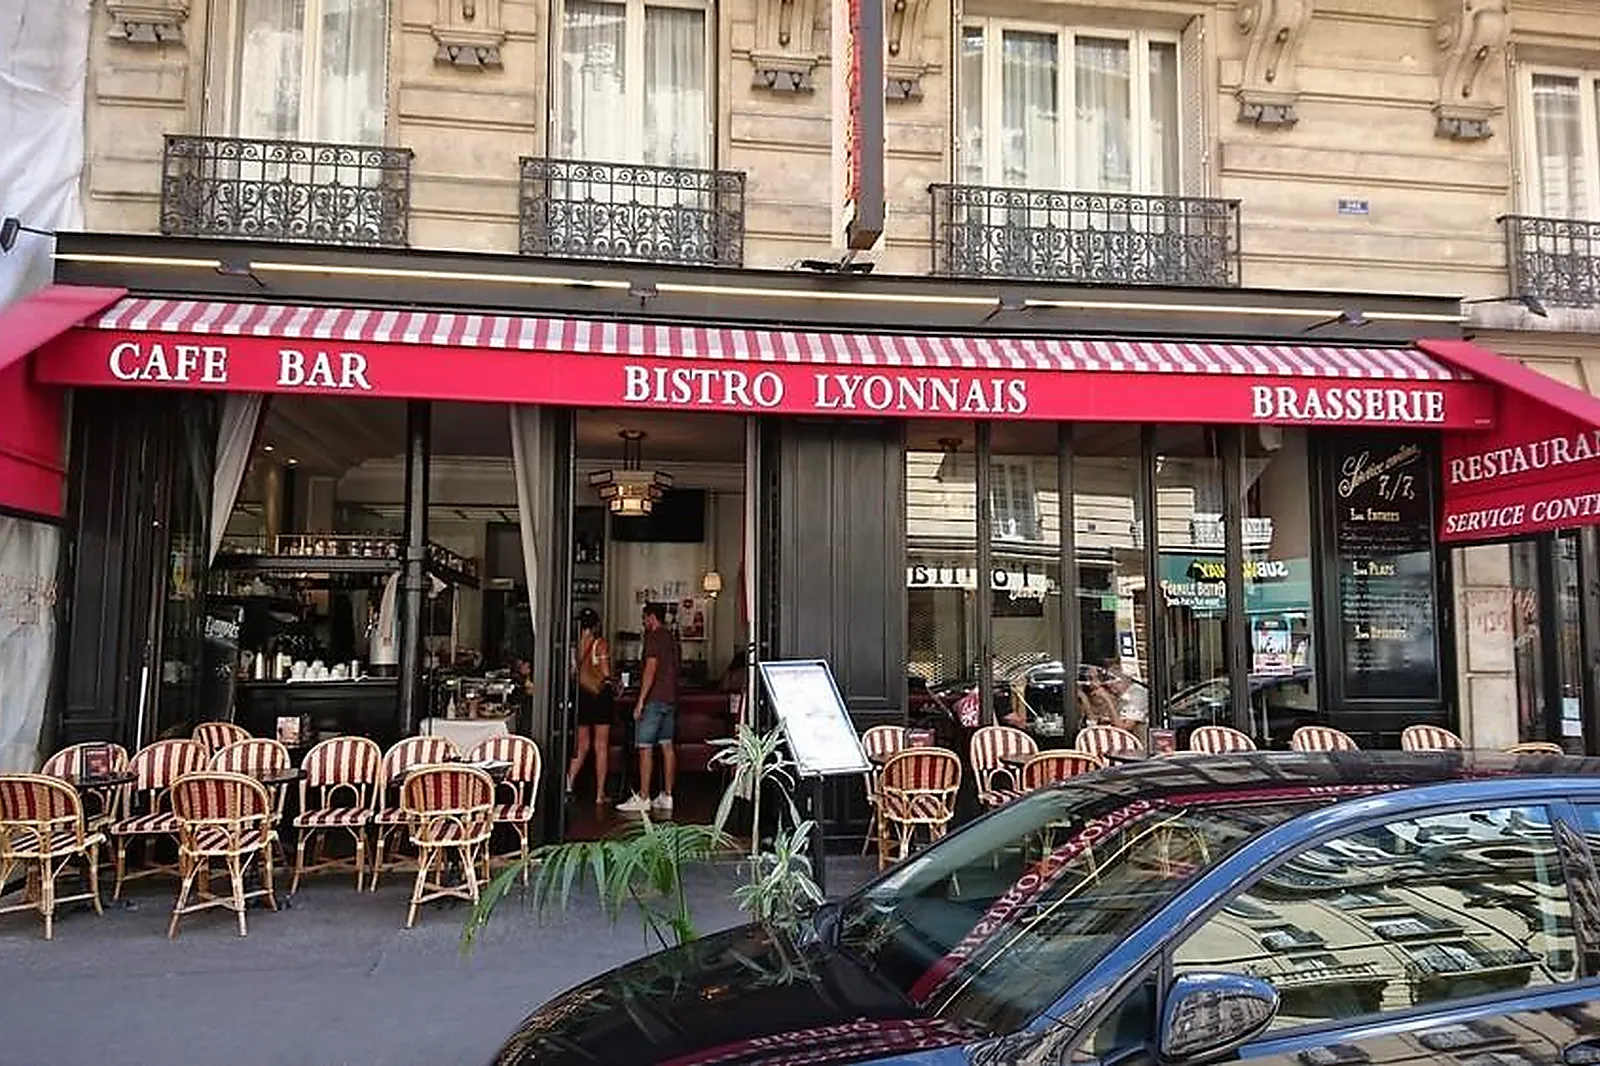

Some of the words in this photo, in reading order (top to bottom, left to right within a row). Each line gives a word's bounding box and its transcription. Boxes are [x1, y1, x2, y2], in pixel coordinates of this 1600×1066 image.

[108, 341, 228, 384] CAFE
[276, 349, 371, 390] BAR
[622, 364, 785, 408] BISTRO
[814, 373, 1028, 414] LYONNAIS
[1250, 384, 1446, 423] BRASSERIE
[1445, 504, 1526, 534] SERVICE
